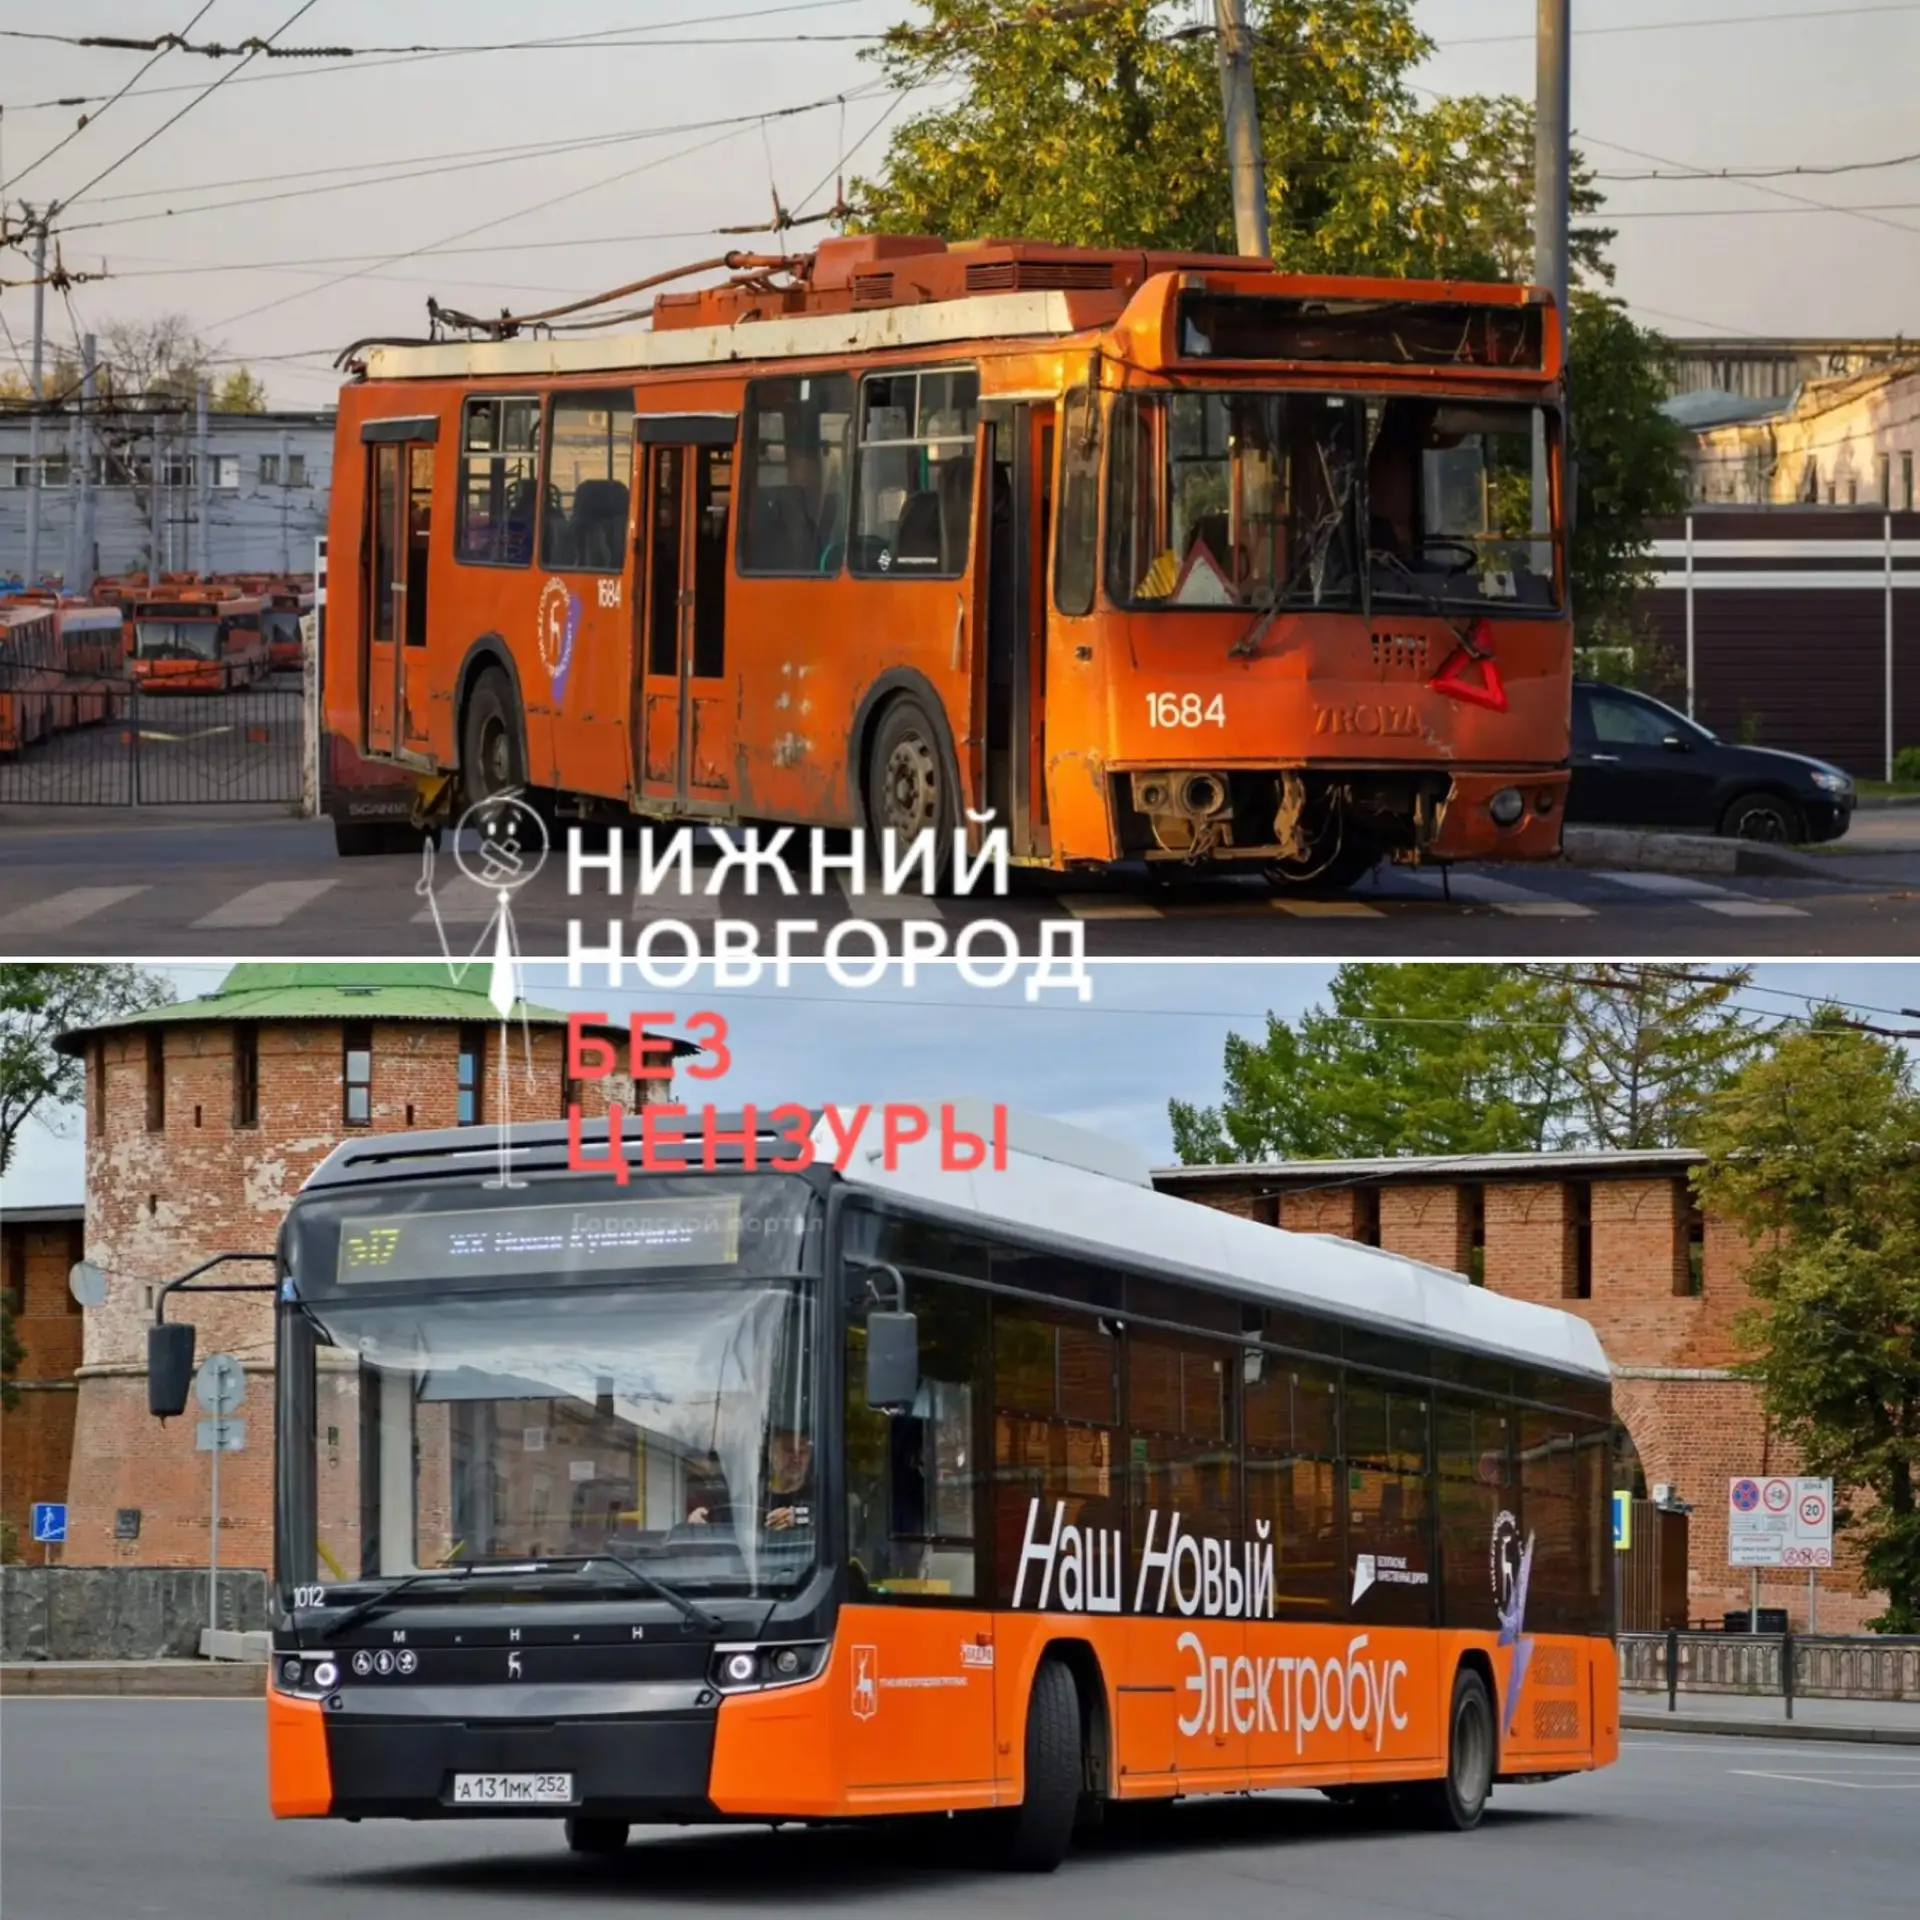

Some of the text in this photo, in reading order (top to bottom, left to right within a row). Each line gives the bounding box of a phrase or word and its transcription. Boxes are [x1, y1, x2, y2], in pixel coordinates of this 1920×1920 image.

[597, 579, 622, 608] 1684
[1146, 691, 1226, 729] 1684
[1805, 1504, 1819, 1516] 20
[1012, 1498, 1274, 1618] Наш Новый
[293, 1587, 325, 1607] 1012
[1177, 1631, 1408, 1754] Электробус
